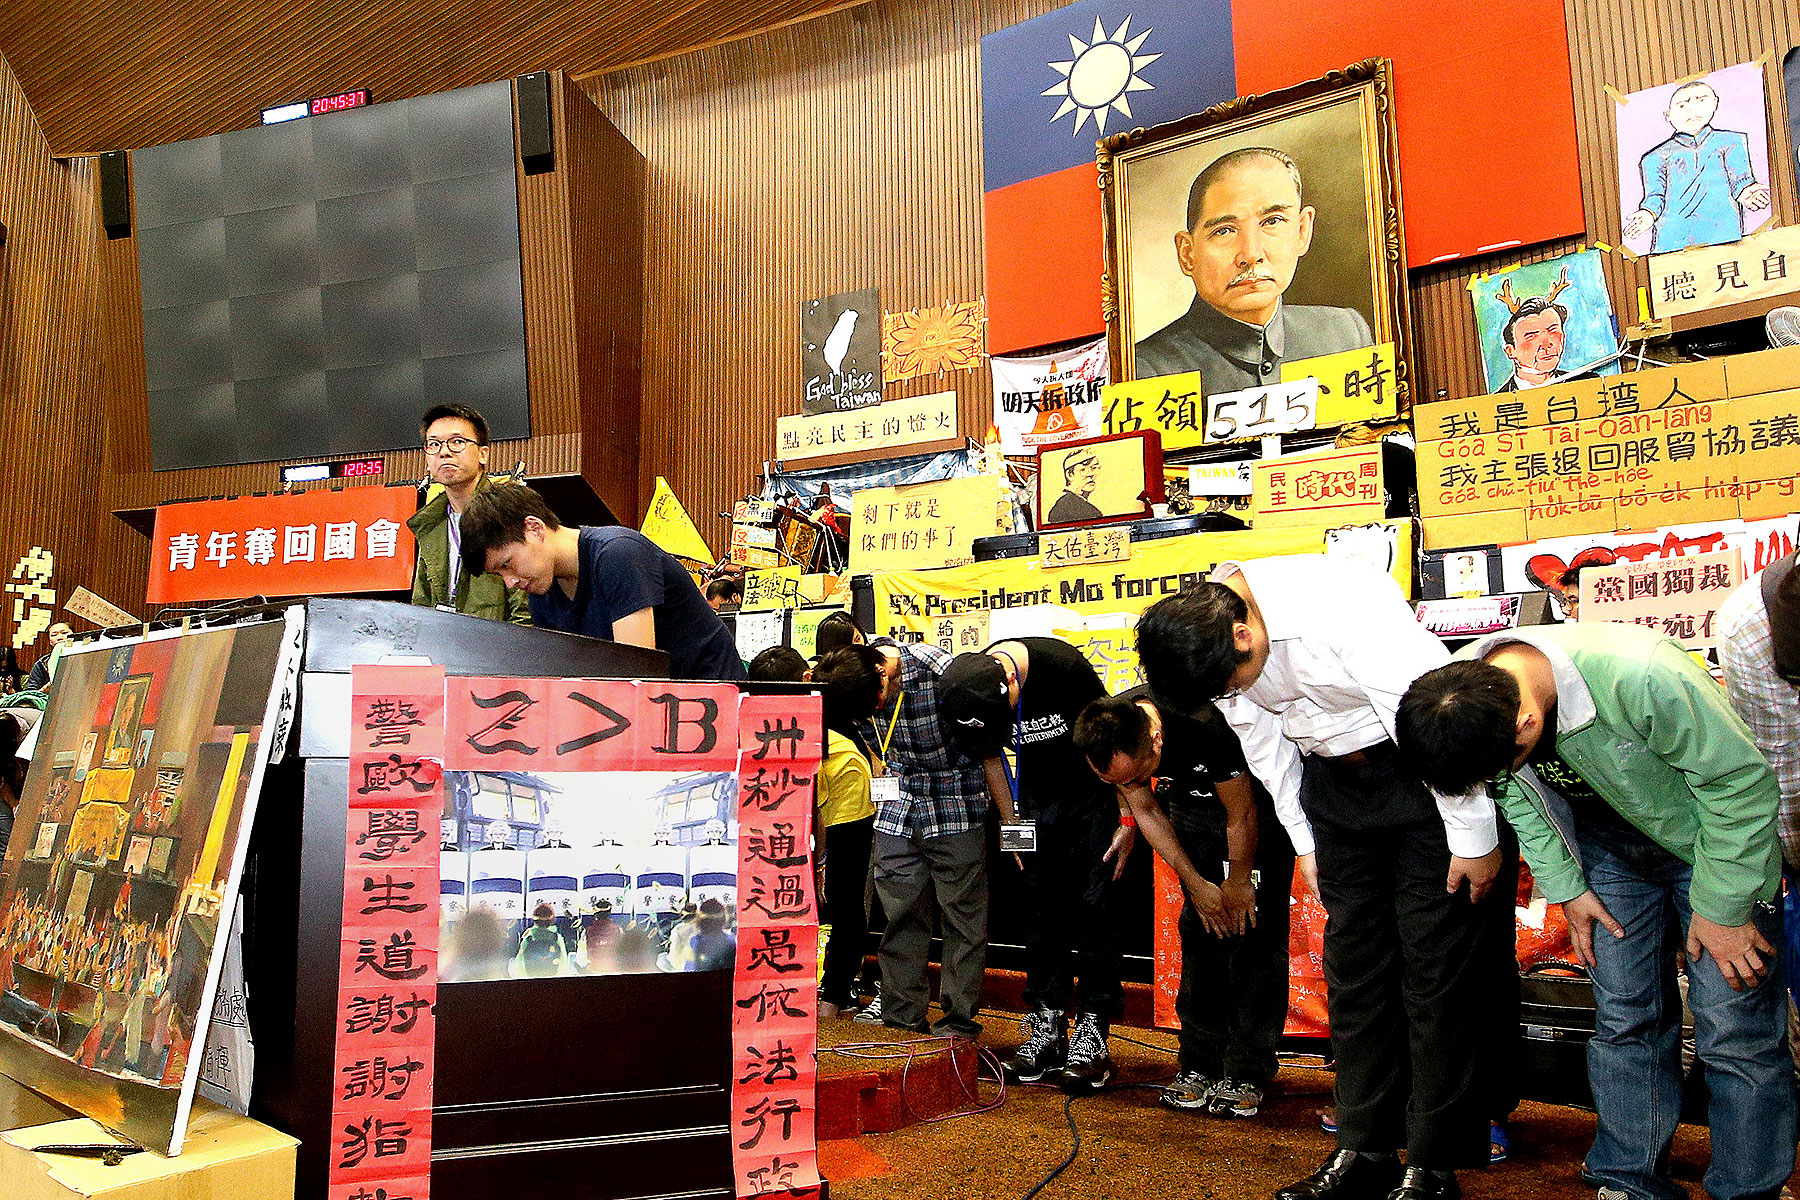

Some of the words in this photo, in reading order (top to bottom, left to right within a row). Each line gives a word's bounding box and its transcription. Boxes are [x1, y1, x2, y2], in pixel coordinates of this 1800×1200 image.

[312, 91, 365, 114] 20:45:37
[1662, 250, 1787, 302] 聽見自
[806, 372, 835, 402] God
[840, 369, 873, 393] bless
[830, 391, 882, 409] Taiwan
[1002, 376, 1106, 413] 明天拆政府
[1103, 389, 1199, 435] 佔領
[1209, 391, 1310, 439] 515
[1439, 377, 1698, 439] 我是台湾人
[782, 411, 950, 450] 點亮民主的燈火
[1439, 413, 1800, 487] 我主張退回服貿協議
[1195, 467, 1236, 479] TAIWAN
[1270, 472, 1287, 506] 民主
[1296, 470, 1356, 501] 時代
[1358, 462, 1378, 500] 周刊
[168, 518, 401, 572] 青年奪回國會
[861, 526, 956, 552] 你們的事了
[1045, 531, 1124, 560] 天佑臺灣
[925, 586, 1052, 616] President
[1593, 562, 1732, 604] 黨國獨裁
